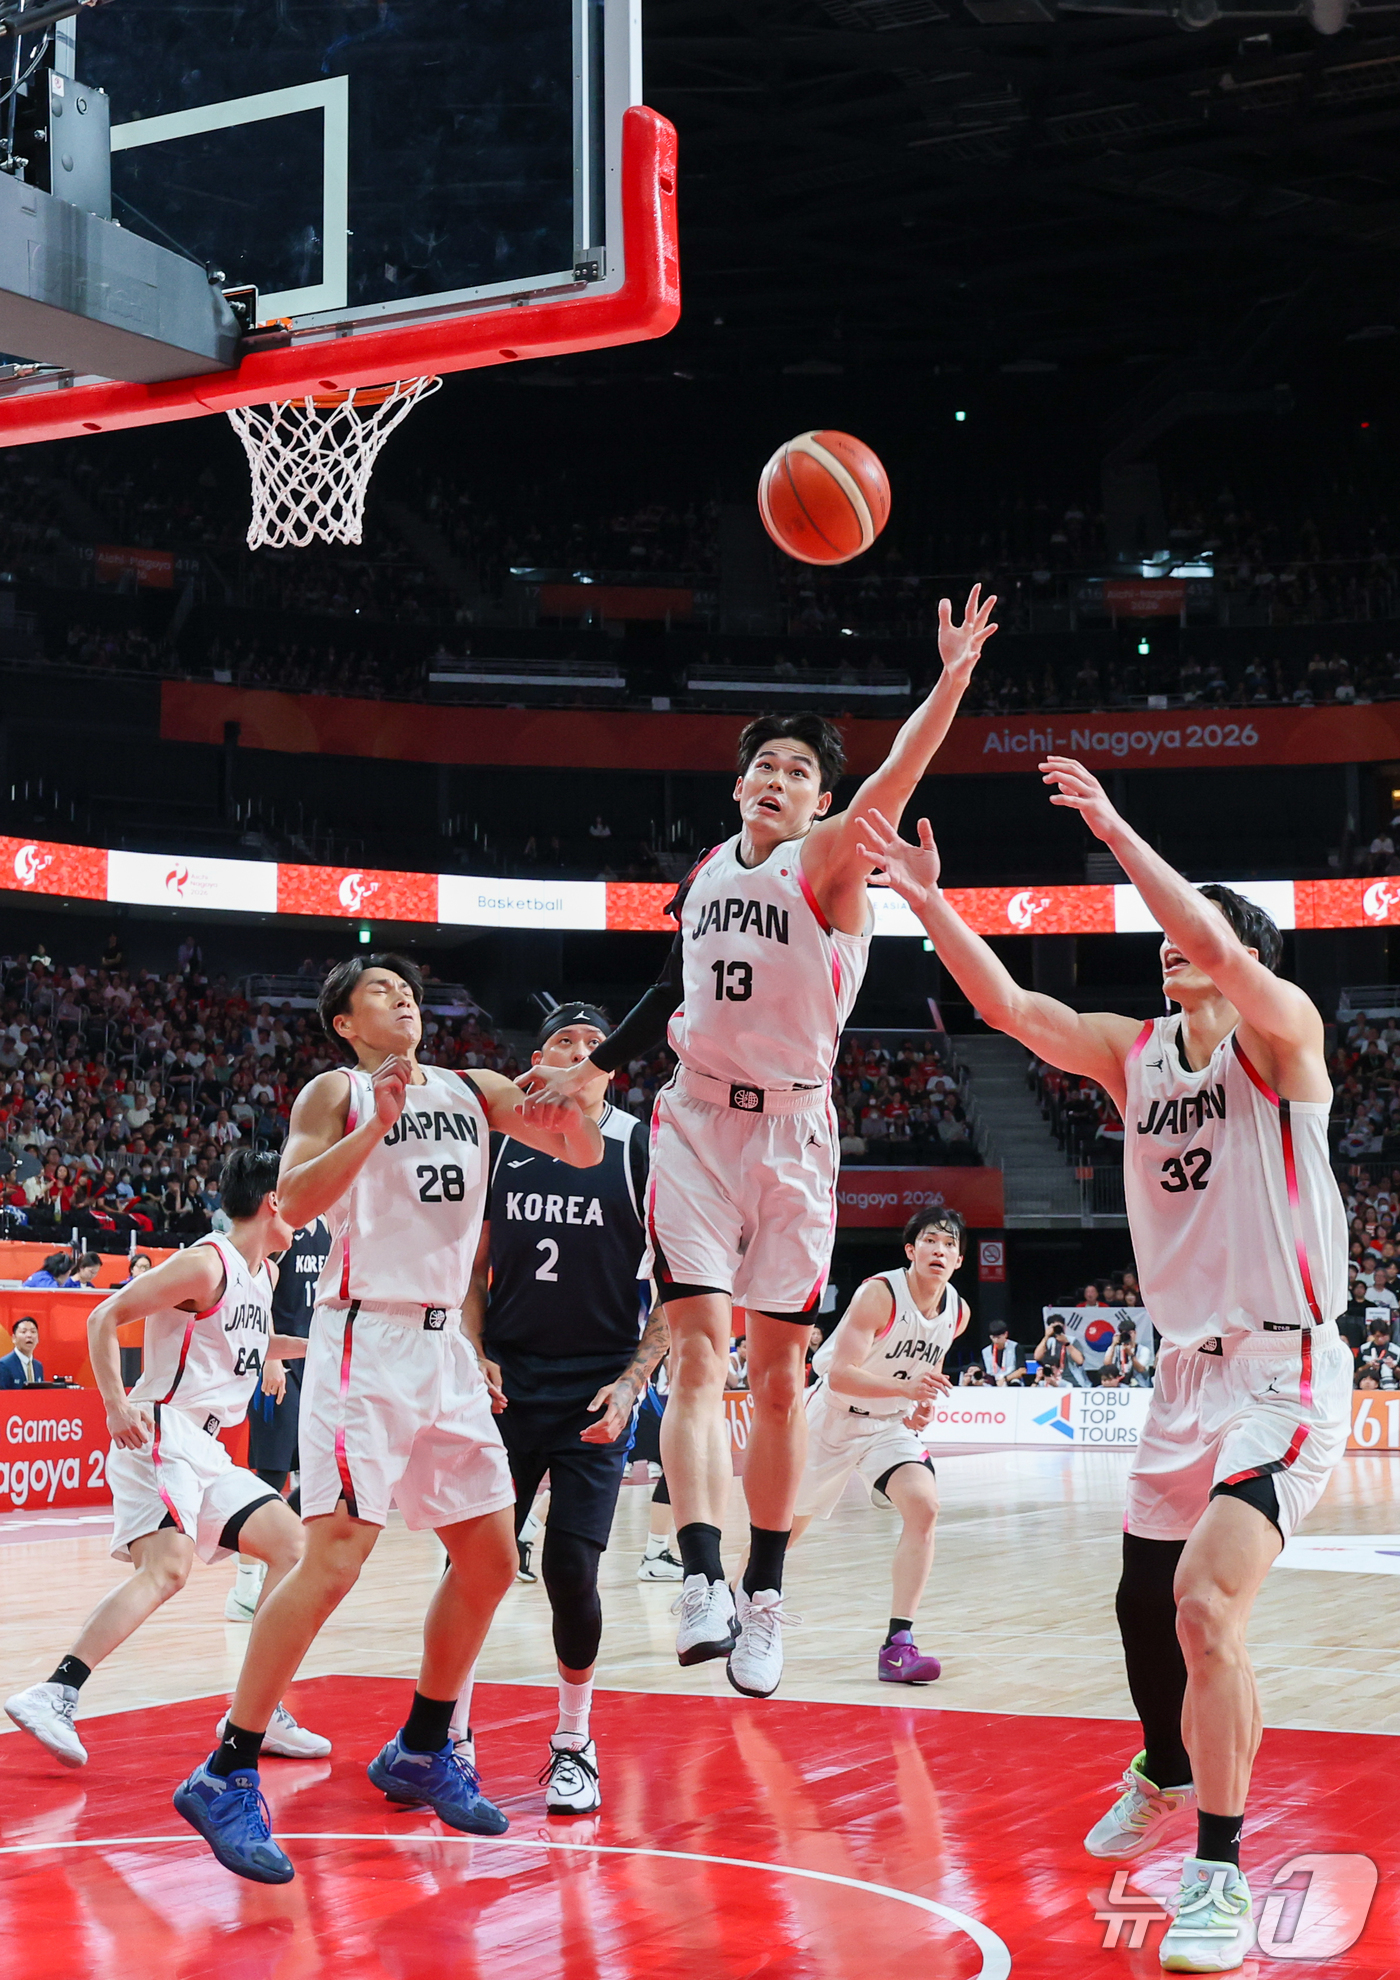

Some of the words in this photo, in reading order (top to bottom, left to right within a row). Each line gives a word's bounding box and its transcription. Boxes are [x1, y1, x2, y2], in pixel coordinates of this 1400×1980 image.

[983, 727, 1181, 757] Aichi-Nagoya
[1186, 724, 1259, 748] 2026
[478, 895, 563, 911] Basketball
[882, 902, 908, 910] ASIA
[692, 898, 789, 945] JAPAN
[711, 959, 753, 1002] 13
[1137, 1083, 1226, 1135] JAPAN
[384, 1111, 479, 1148] JAPAN
[416, 1164, 465, 1203] 28
[1160, 1147, 1212, 1193] 32
[505, 1191, 604, 1227] KOREA
[902, 1190, 945, 1205] 2026
[295, 1254, 328, 1273] KORE
[535, 1237, 560, 1282] 2
[233, 1347, 261, 1377] 64
[885, 1339, 944, 1366] JAPAN
[1080, 1391, 1130, 1407] TOBU
[932, 1405, 1006, 1424] ocomo
[1080, 1409, 1116, 1424] TOP
[6, 1415, 83, 1444] Games
[1079, 1427, 1138, 1443] TOURS
